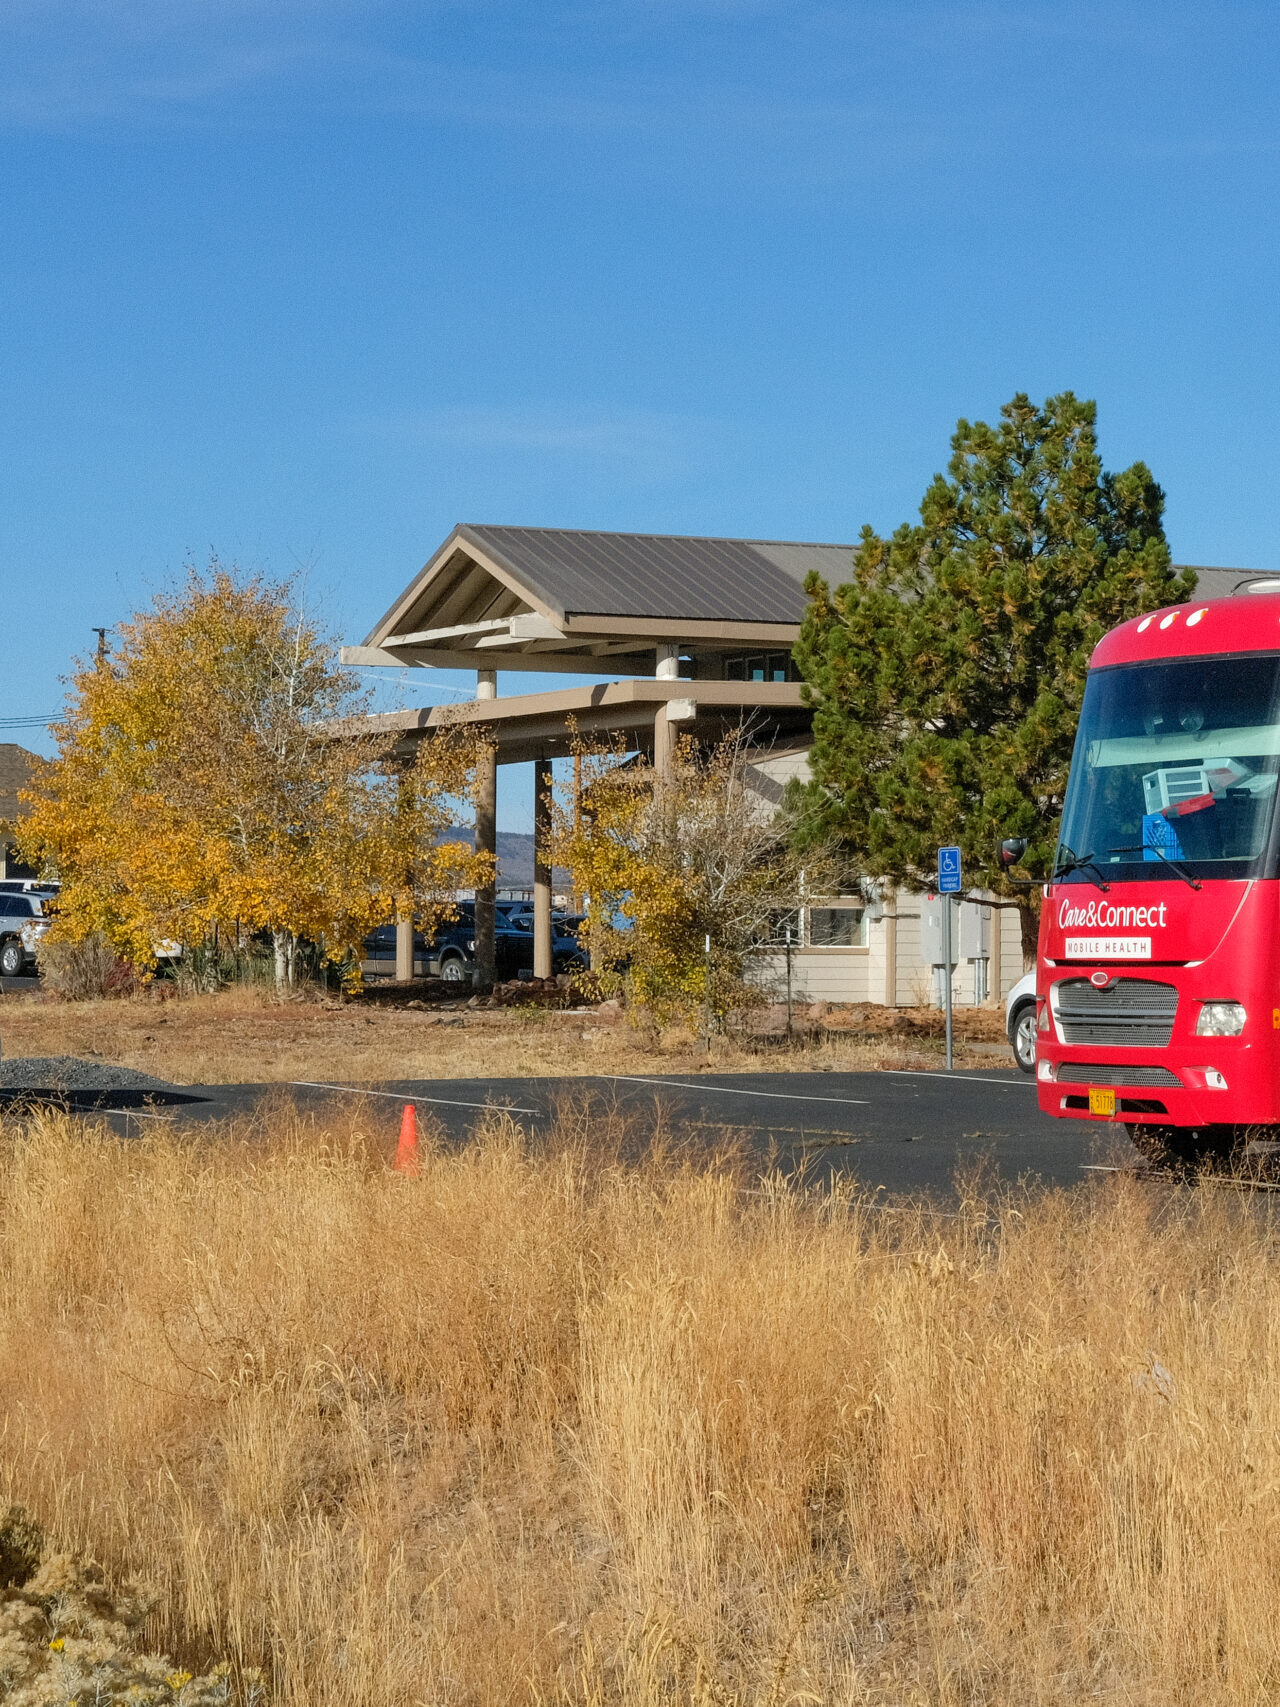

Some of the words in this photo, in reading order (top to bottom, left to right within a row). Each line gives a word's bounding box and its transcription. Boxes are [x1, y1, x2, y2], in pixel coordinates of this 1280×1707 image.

[1058, 898, 1167, 929] Care&Connect
[1067, 942, 1100, 953] MOBILE
[1105, 942, 1147, 953] HEALTH
